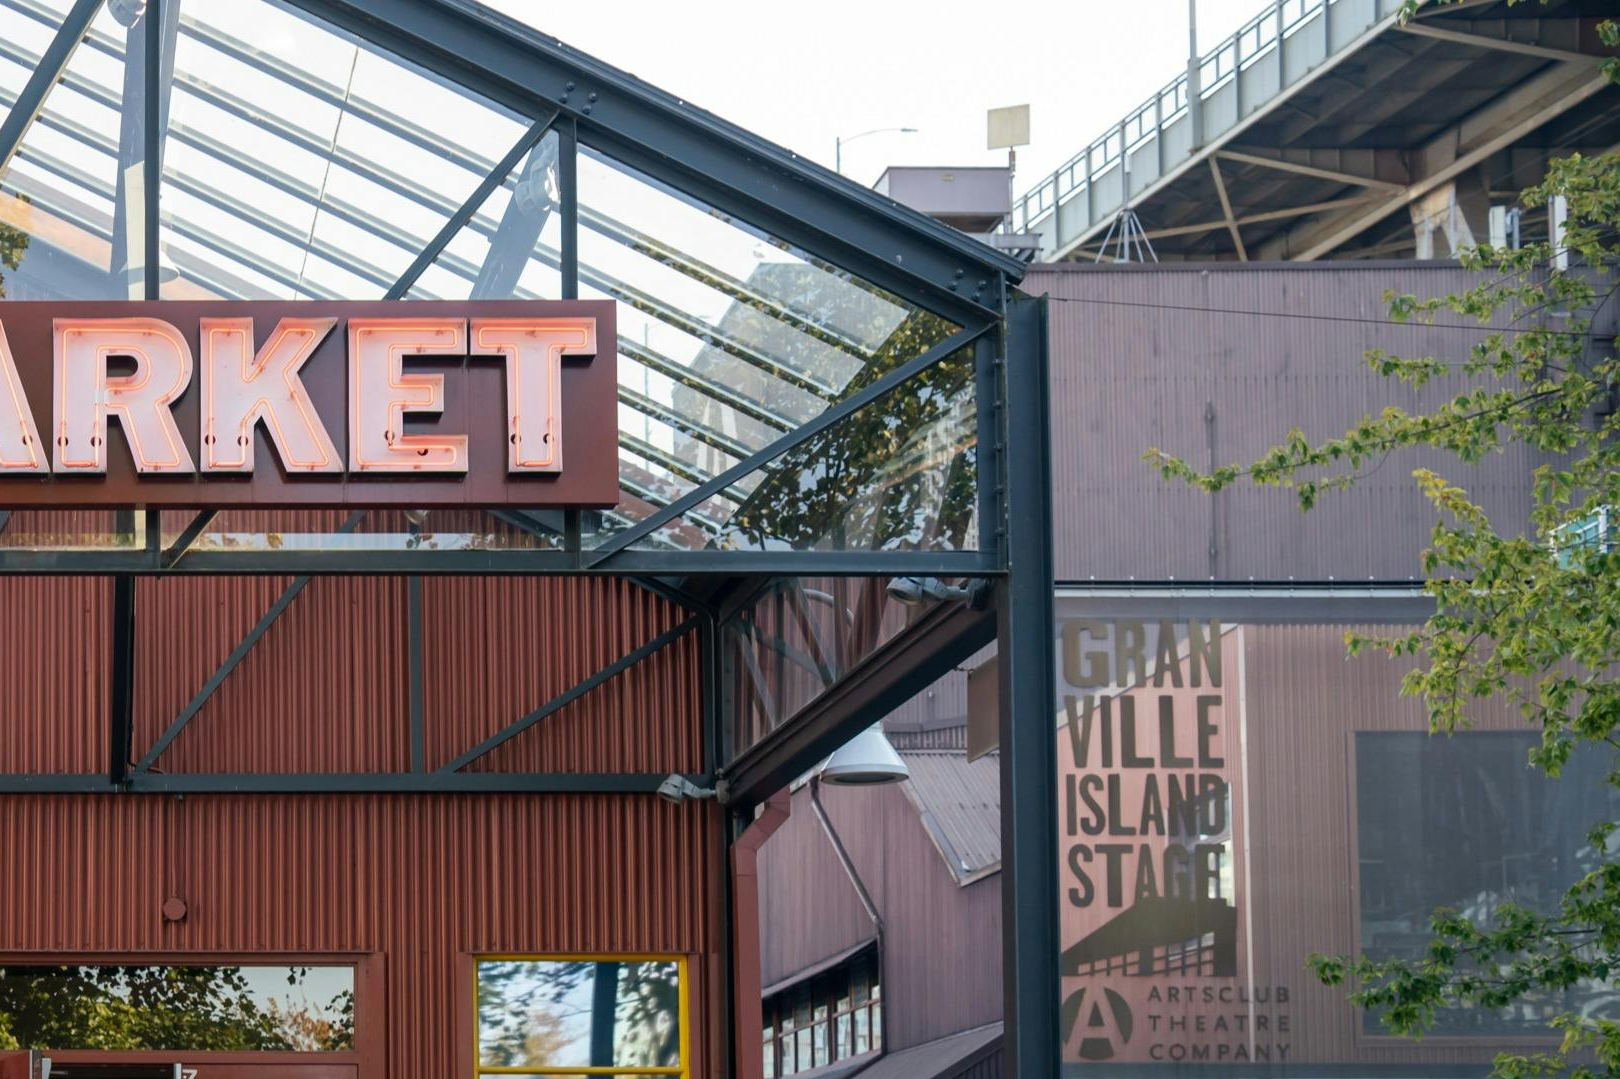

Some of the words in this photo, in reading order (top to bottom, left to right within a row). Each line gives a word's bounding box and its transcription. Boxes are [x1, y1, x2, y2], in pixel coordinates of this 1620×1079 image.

[1062, 617, 1223, 689] GRAN
[1063, 694, 1225, 769] VILLE
[1065, 773, 1227, 837] ISLAND
[1067, 843, 1228, 908] STAGE
[1147, 985, 1290, 1003] ARTSCLUB
[1147, 1015, 1291, 1032] THEATRE
[1149, 1043, 1291, 1061] COMPANY
